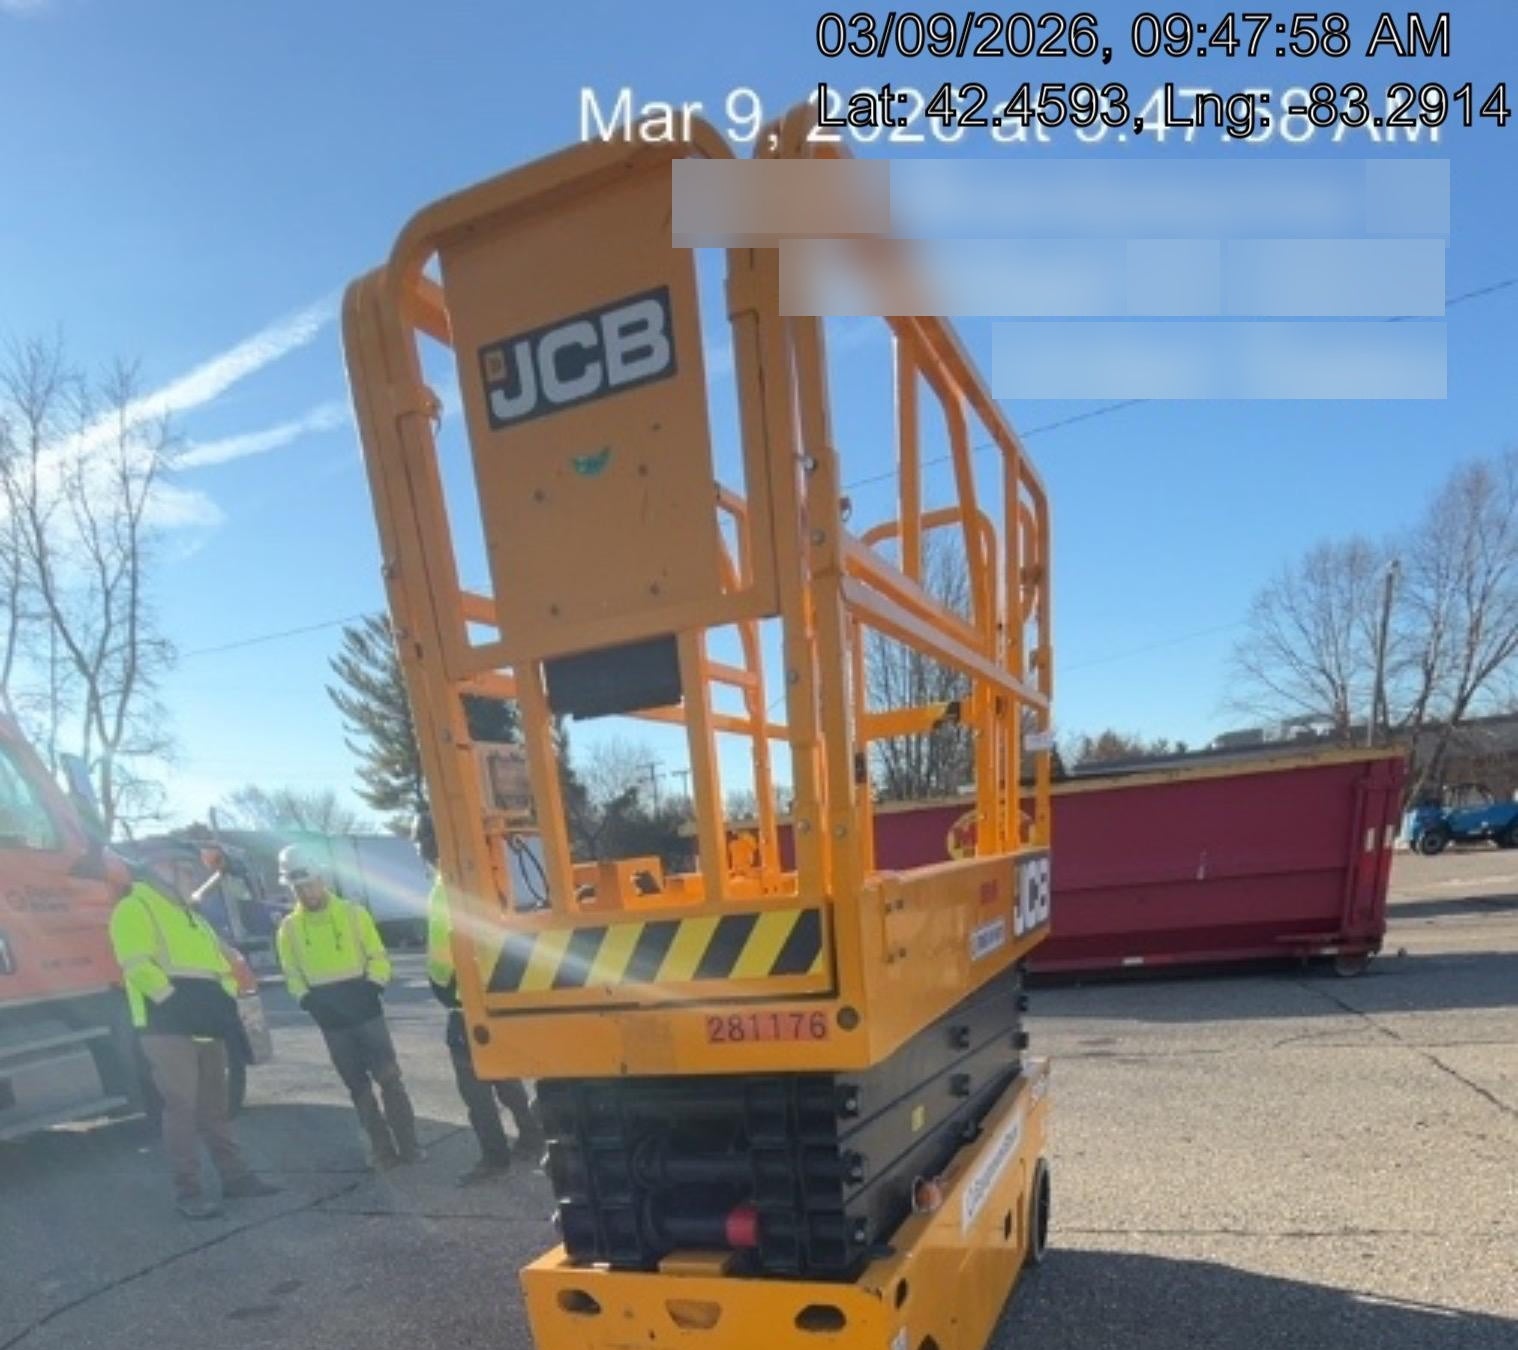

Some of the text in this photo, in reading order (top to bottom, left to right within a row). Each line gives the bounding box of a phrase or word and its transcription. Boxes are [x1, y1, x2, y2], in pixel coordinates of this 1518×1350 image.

[490, 299, 671, 419] JCB
[1012, 857, 1050, 936] JCB
[708, 1011, 827, 1043] 281176
